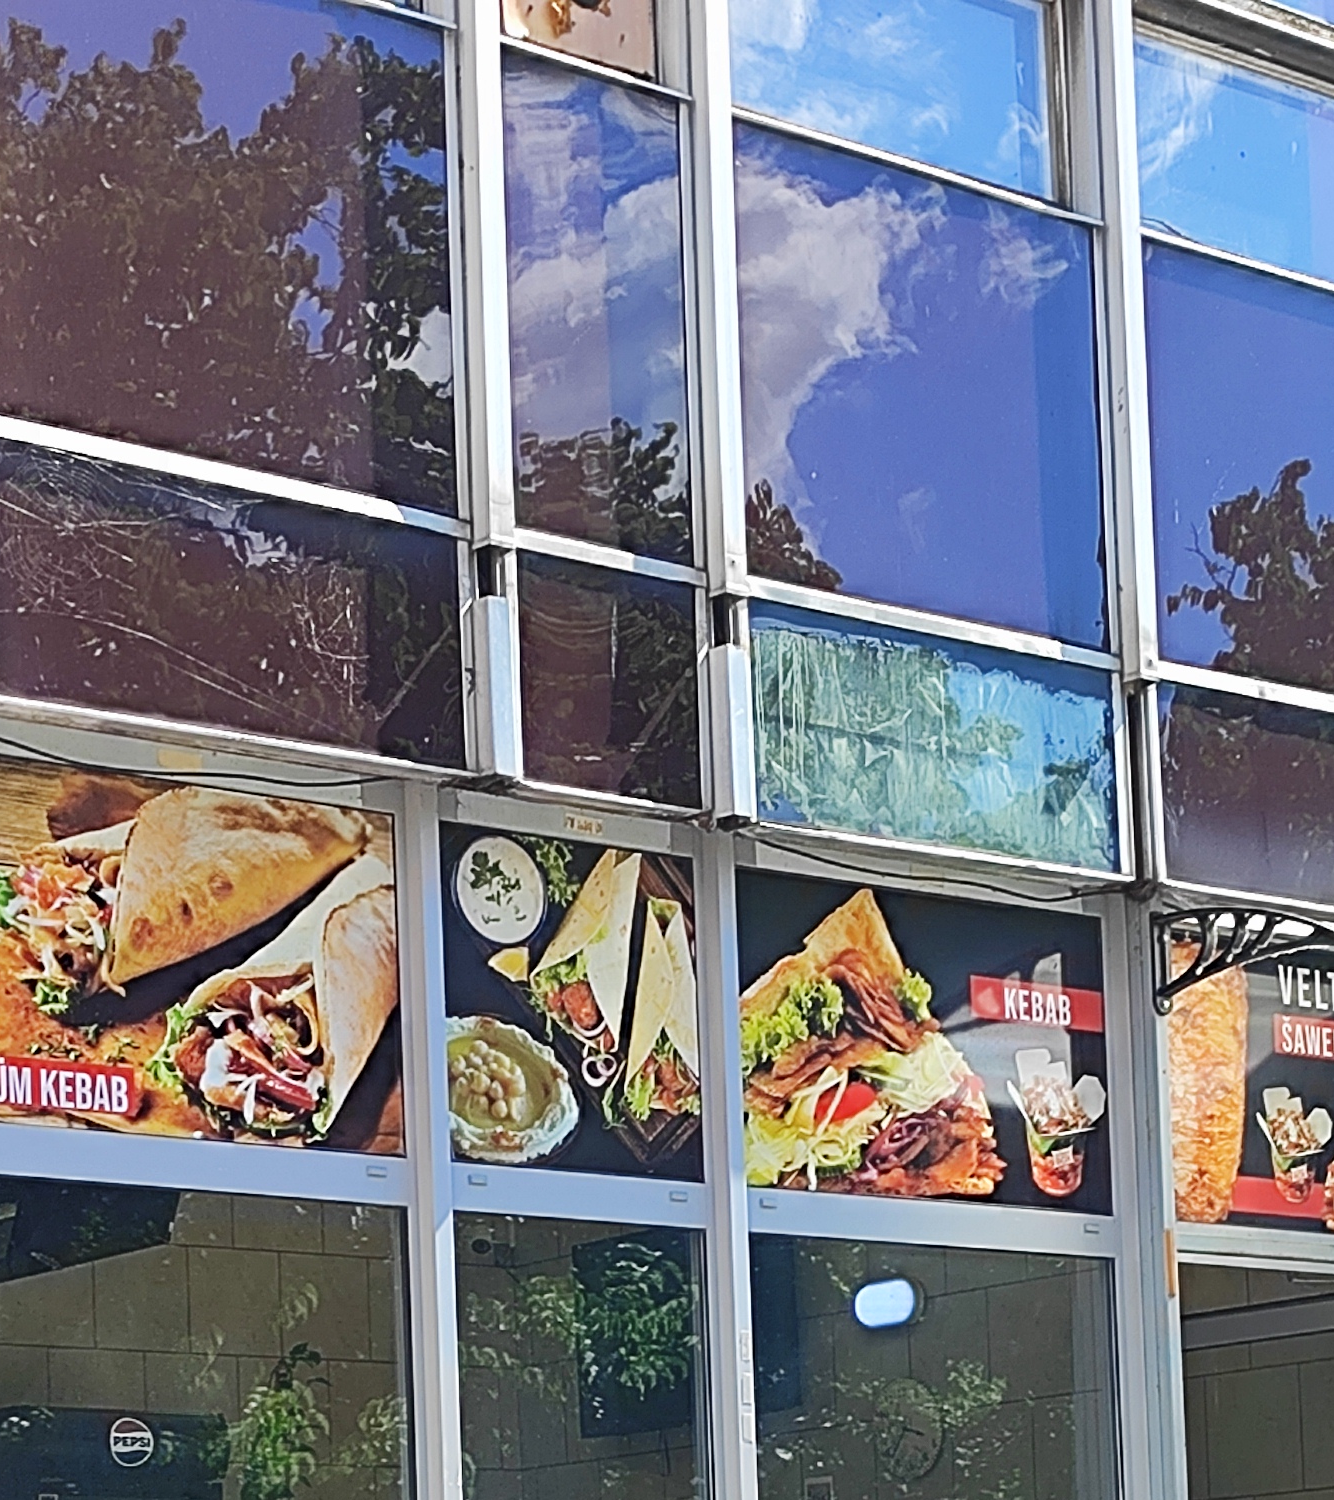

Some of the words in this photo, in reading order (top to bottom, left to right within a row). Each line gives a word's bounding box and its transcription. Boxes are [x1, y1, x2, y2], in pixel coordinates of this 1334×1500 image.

[1004, 987, 1071, 1026] KEBAB
[39, 1068, 129, 1114] KEBAB
[113, 1436, 151, 1447] PEPSI
